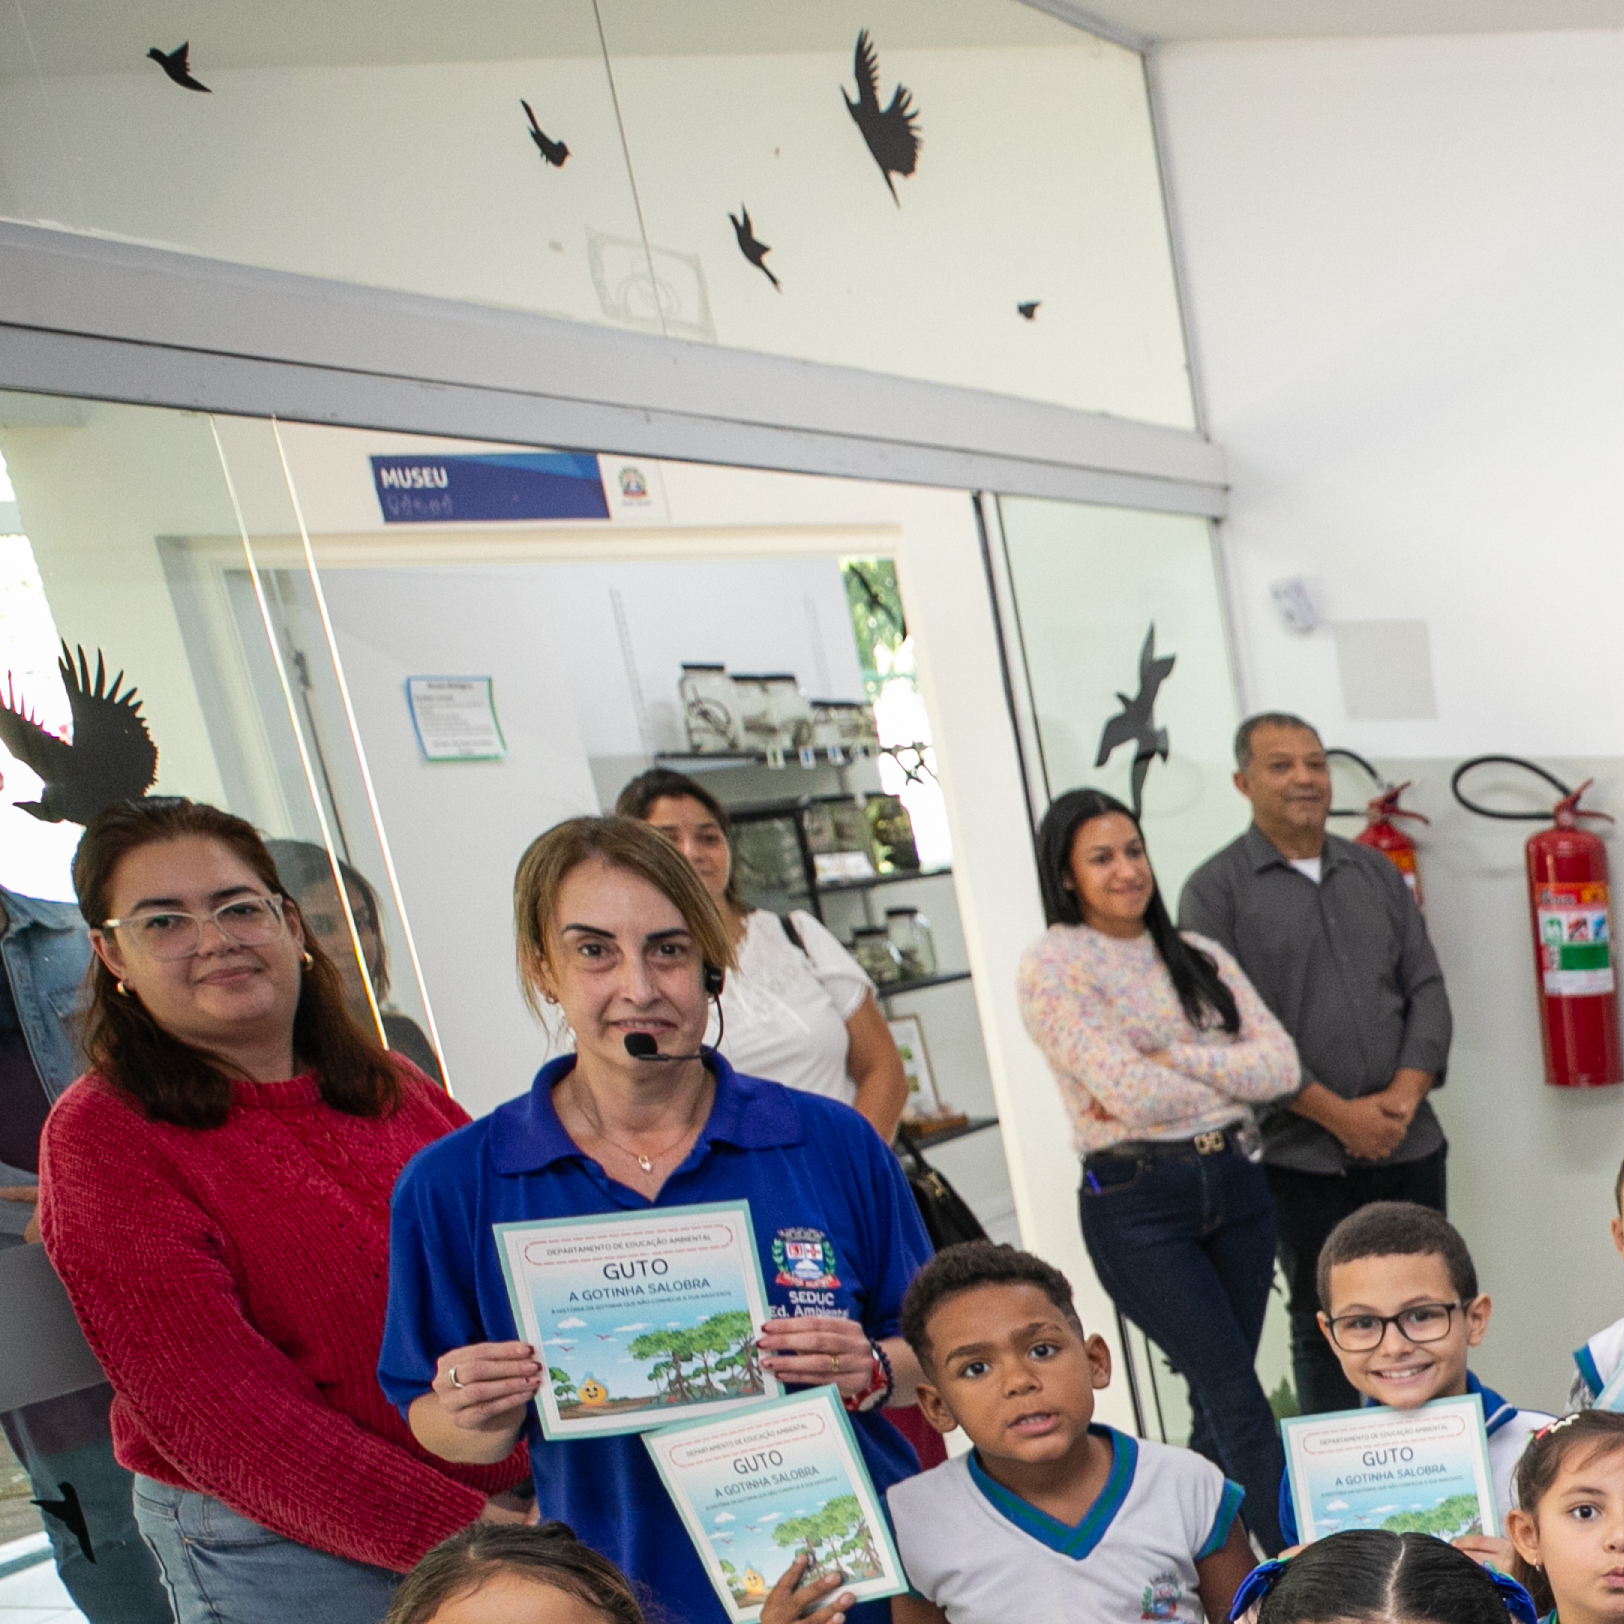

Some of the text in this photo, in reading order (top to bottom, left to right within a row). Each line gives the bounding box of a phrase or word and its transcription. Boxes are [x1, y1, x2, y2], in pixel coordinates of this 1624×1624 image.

[380, 466, 449, 489] MUSEU
[547, 1244, 611, 1256] DEPARTAMENTO
[625, 1237, 668, 1248] EDUCAÇÃO
[669, 1235, 711, 1243] AMBIENTAL
[603, 1259, 668, 1280] GUTO
[569, 1279, 710, 1302] A GOTINHA SALOBRA
[788, 1290, 835, 1306] SEDUC
[733, 1450, 783, 1474] GUTO
[1363, 1447, 1413, 1466] GUTO
[715, 1466, 819, 1498] A GOTINHA SALOBRA
[1336, 1464, 1446, 1486] A GOTINHA SALOBRA
